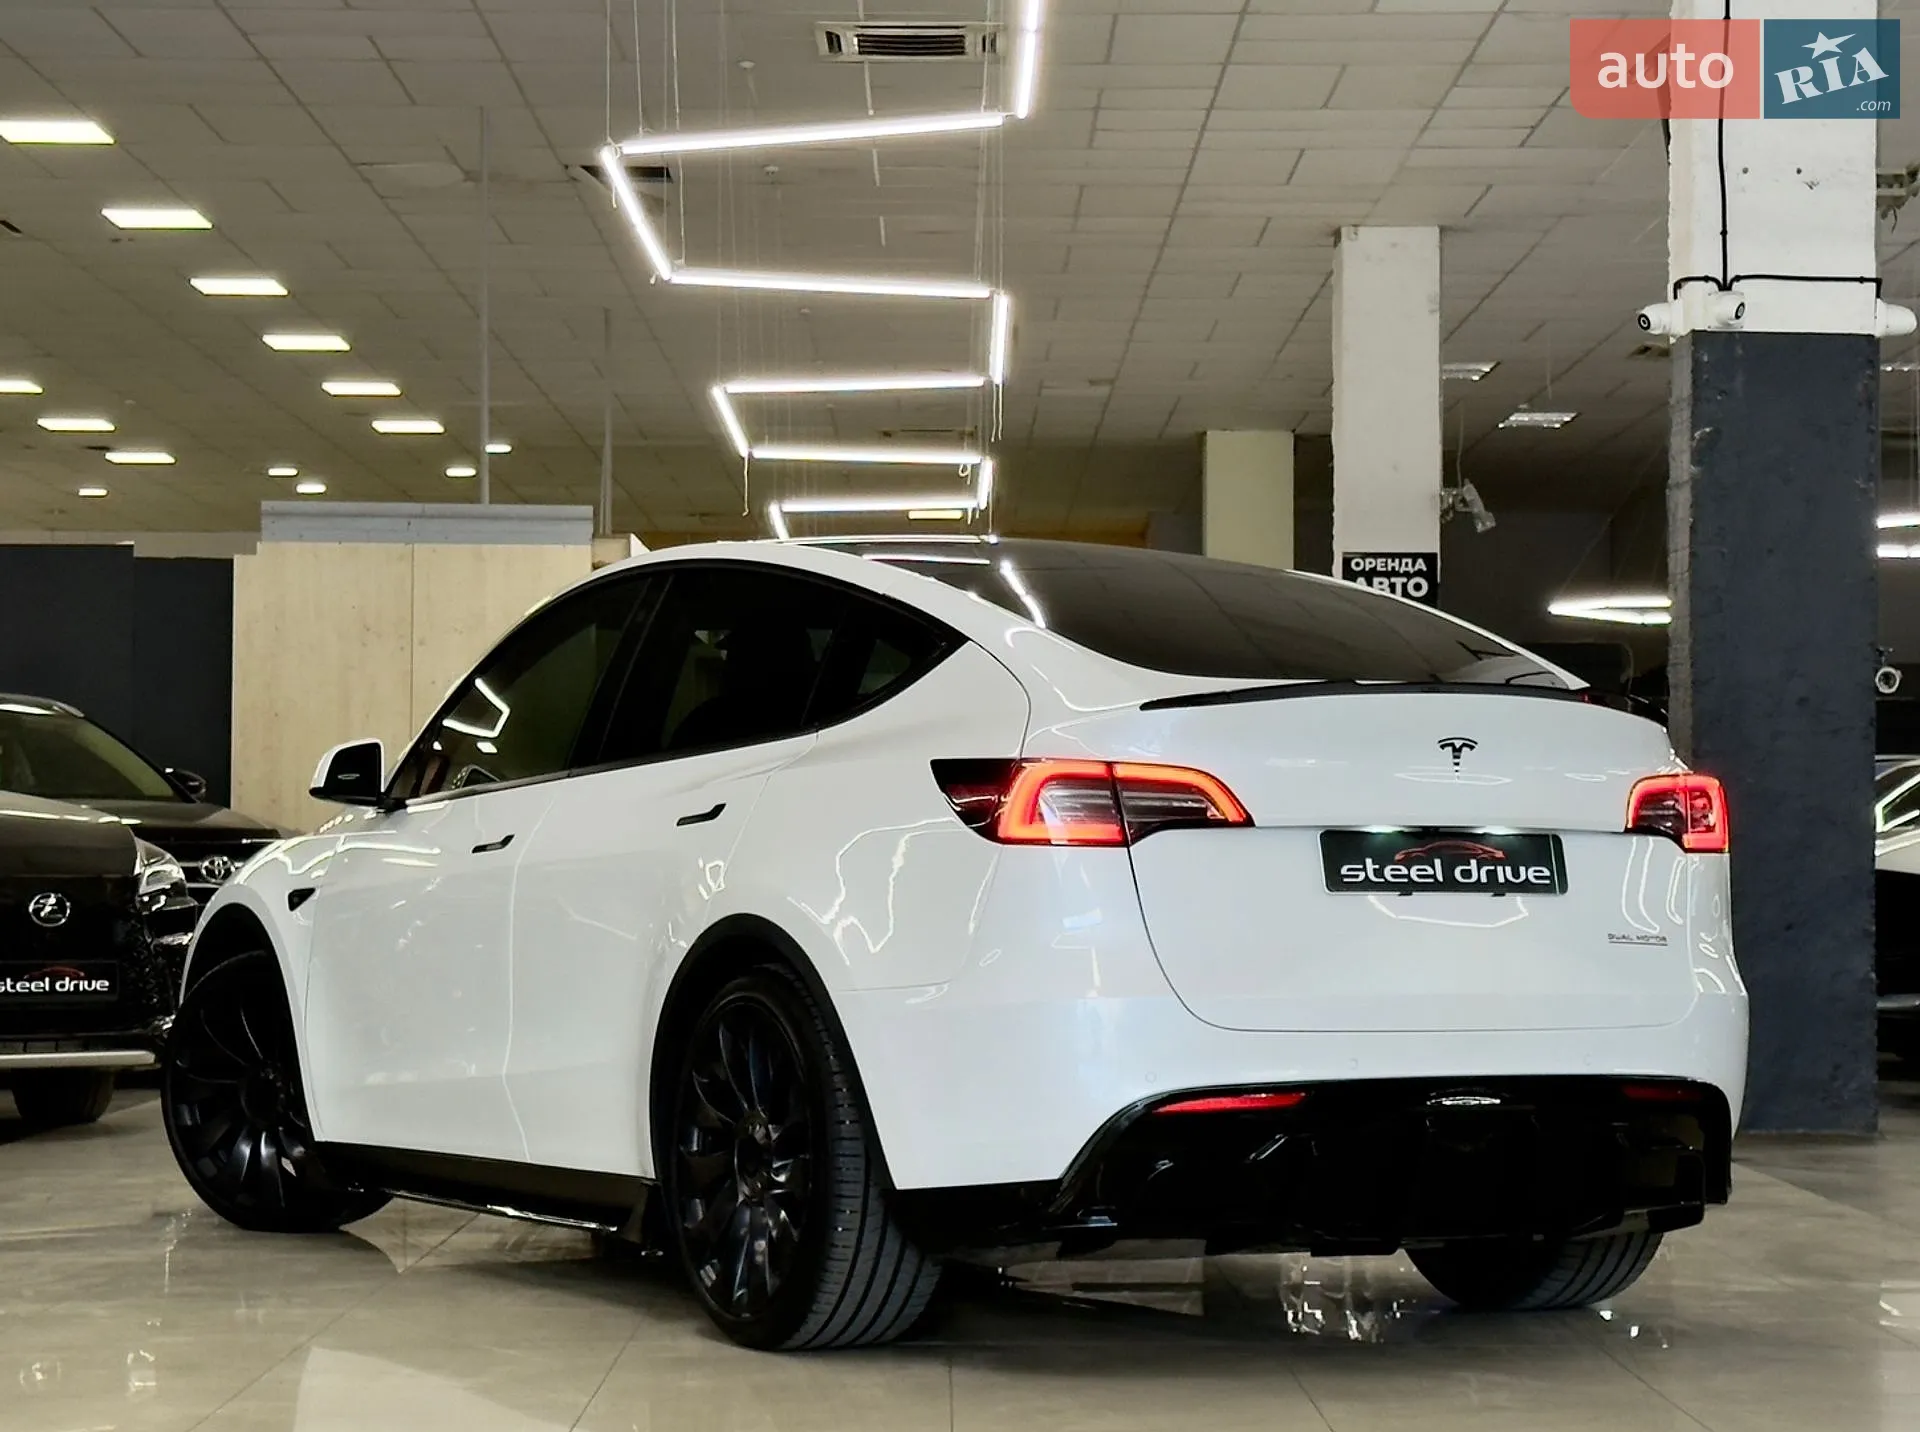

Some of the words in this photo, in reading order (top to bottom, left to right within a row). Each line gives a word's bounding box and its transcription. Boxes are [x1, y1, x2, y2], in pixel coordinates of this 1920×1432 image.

[1350, 558, 1427, 574] ОРЕНДА
[1340, 857, 1444, 883] steel
[1454, 858, 1551, 884] drive
[54, 976, 110, 992] drive
